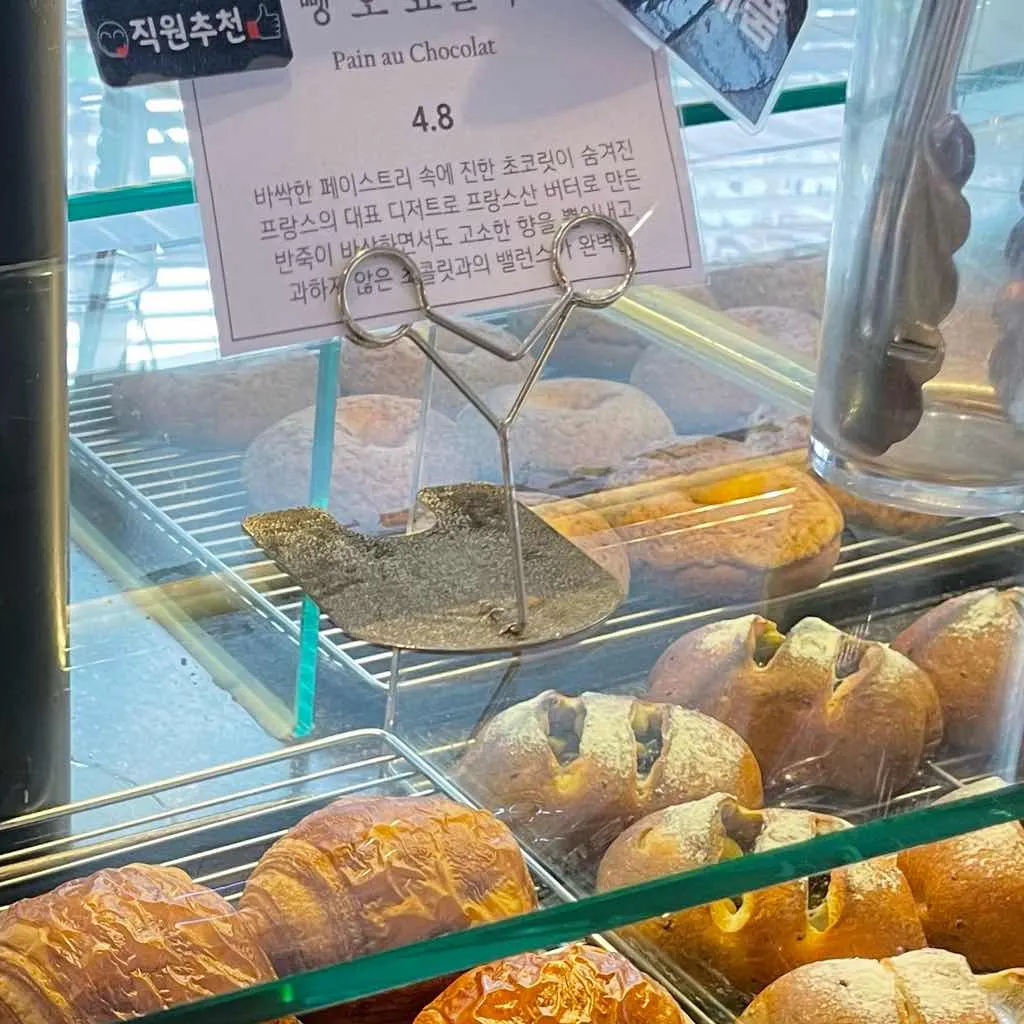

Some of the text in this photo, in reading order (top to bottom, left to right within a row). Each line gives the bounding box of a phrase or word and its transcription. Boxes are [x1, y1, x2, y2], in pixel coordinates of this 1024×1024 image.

[129, 6, 246, 53] 직원추천
[332, 36, 496, 71] Pain au Chocolat
[412, 103, 454, 132] 4.8
[254, 137, 636, 208] 바싹한 페이스트리 속에 진한 초코릿이 숨겨진
[260, 167, 641, 241] 프랑스의 대표 디저트로 프랑스산 버터로 만든
[275, 241, 333, 275] 반죽이
[459, 219, 511, 244] 고소한
[516, 210, 555, 239] 향을
[354, 266, 393, 296] 않은
